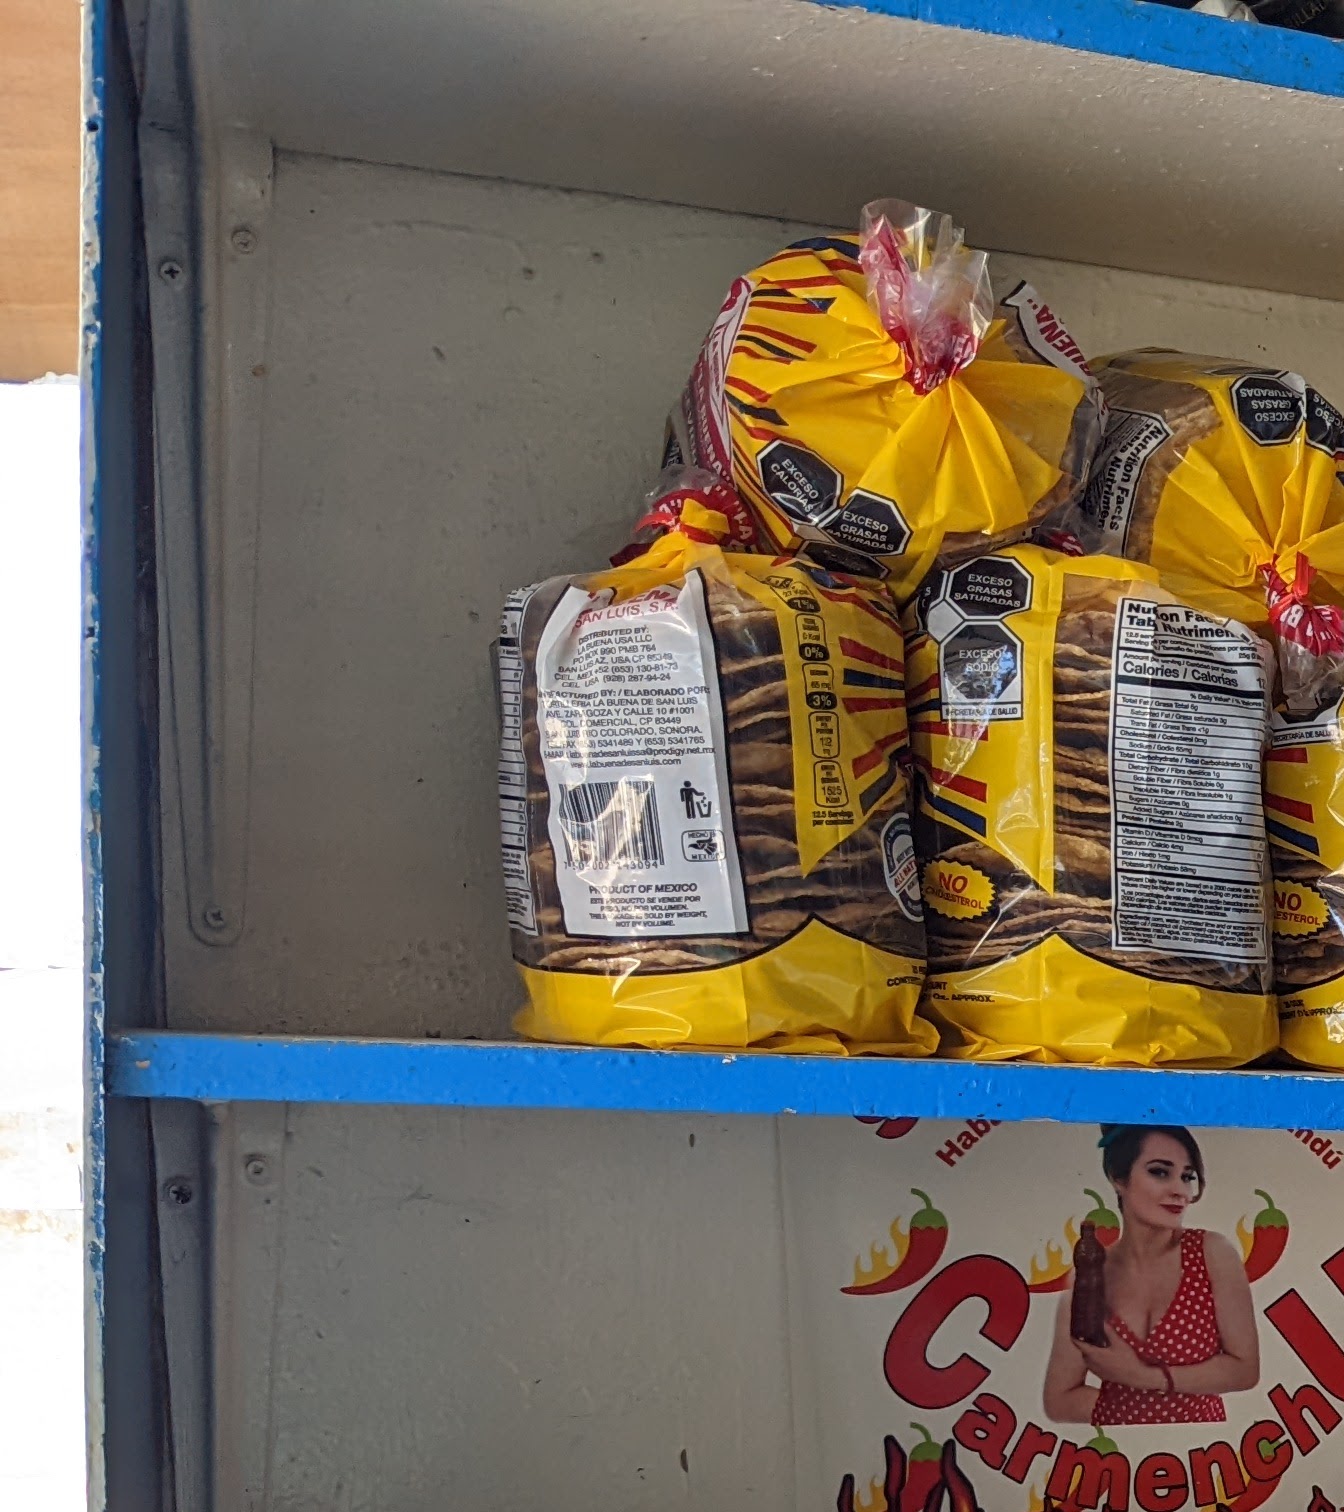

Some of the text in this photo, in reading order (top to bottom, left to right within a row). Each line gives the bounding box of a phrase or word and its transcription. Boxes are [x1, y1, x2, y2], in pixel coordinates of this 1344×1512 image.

[782, 459, 818, 499] EXCESO
[842, 511, 889, 533] EXCESO
[840, 524, 887, 542] GRASAS
[968, 574, 1013, 587] EXCESO
[967, 584, 1013, 597] GRASAS
[954, 592, 1021, 608] SATURADAS
[607, 605, 645, 619] LUIS,
[958, 650, 1001, 659] EXCESO
[1123, 661, 1239, 687] Calories Calorías
[624, 688, 684, 696] ELABORADO
[607, 697, 676, 706] BUENA SAN
[623, 708, 654, 716] CALLE
[600, 727, 657, 738] COLORADO,
[638, 883, 653, 893] OF
[655, 882, 697, 892] MEXICO
[938, 871, 969, 894] NO
